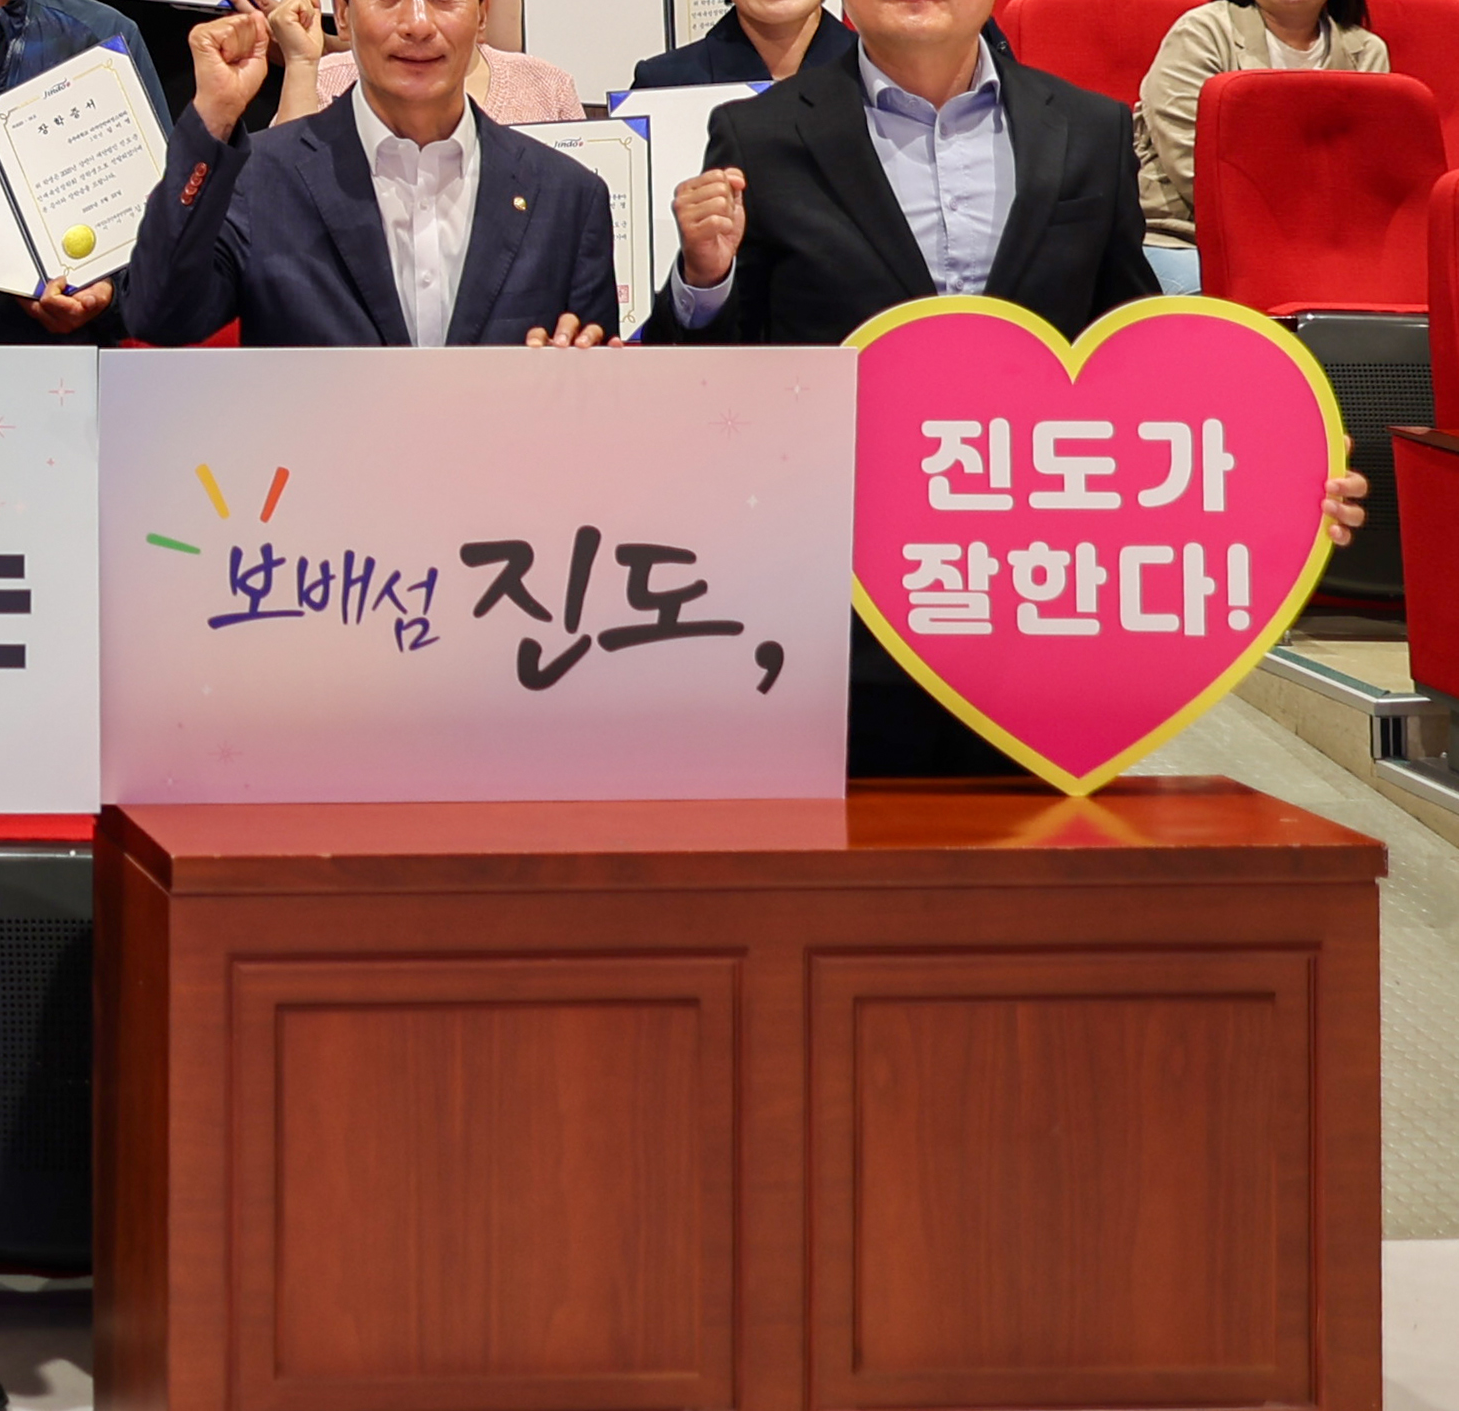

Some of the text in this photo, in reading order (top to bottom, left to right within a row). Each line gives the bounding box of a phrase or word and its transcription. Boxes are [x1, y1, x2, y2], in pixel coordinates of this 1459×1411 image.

[37, 98, 97, 136] 장학증서
[553, 136, 581, 149] Jindo
[919, 416, 1236, 514] 진도가
[208, 524, 786, 695] 보배섬 진도,
[900, 541, 1252, 638] 잘한다!
